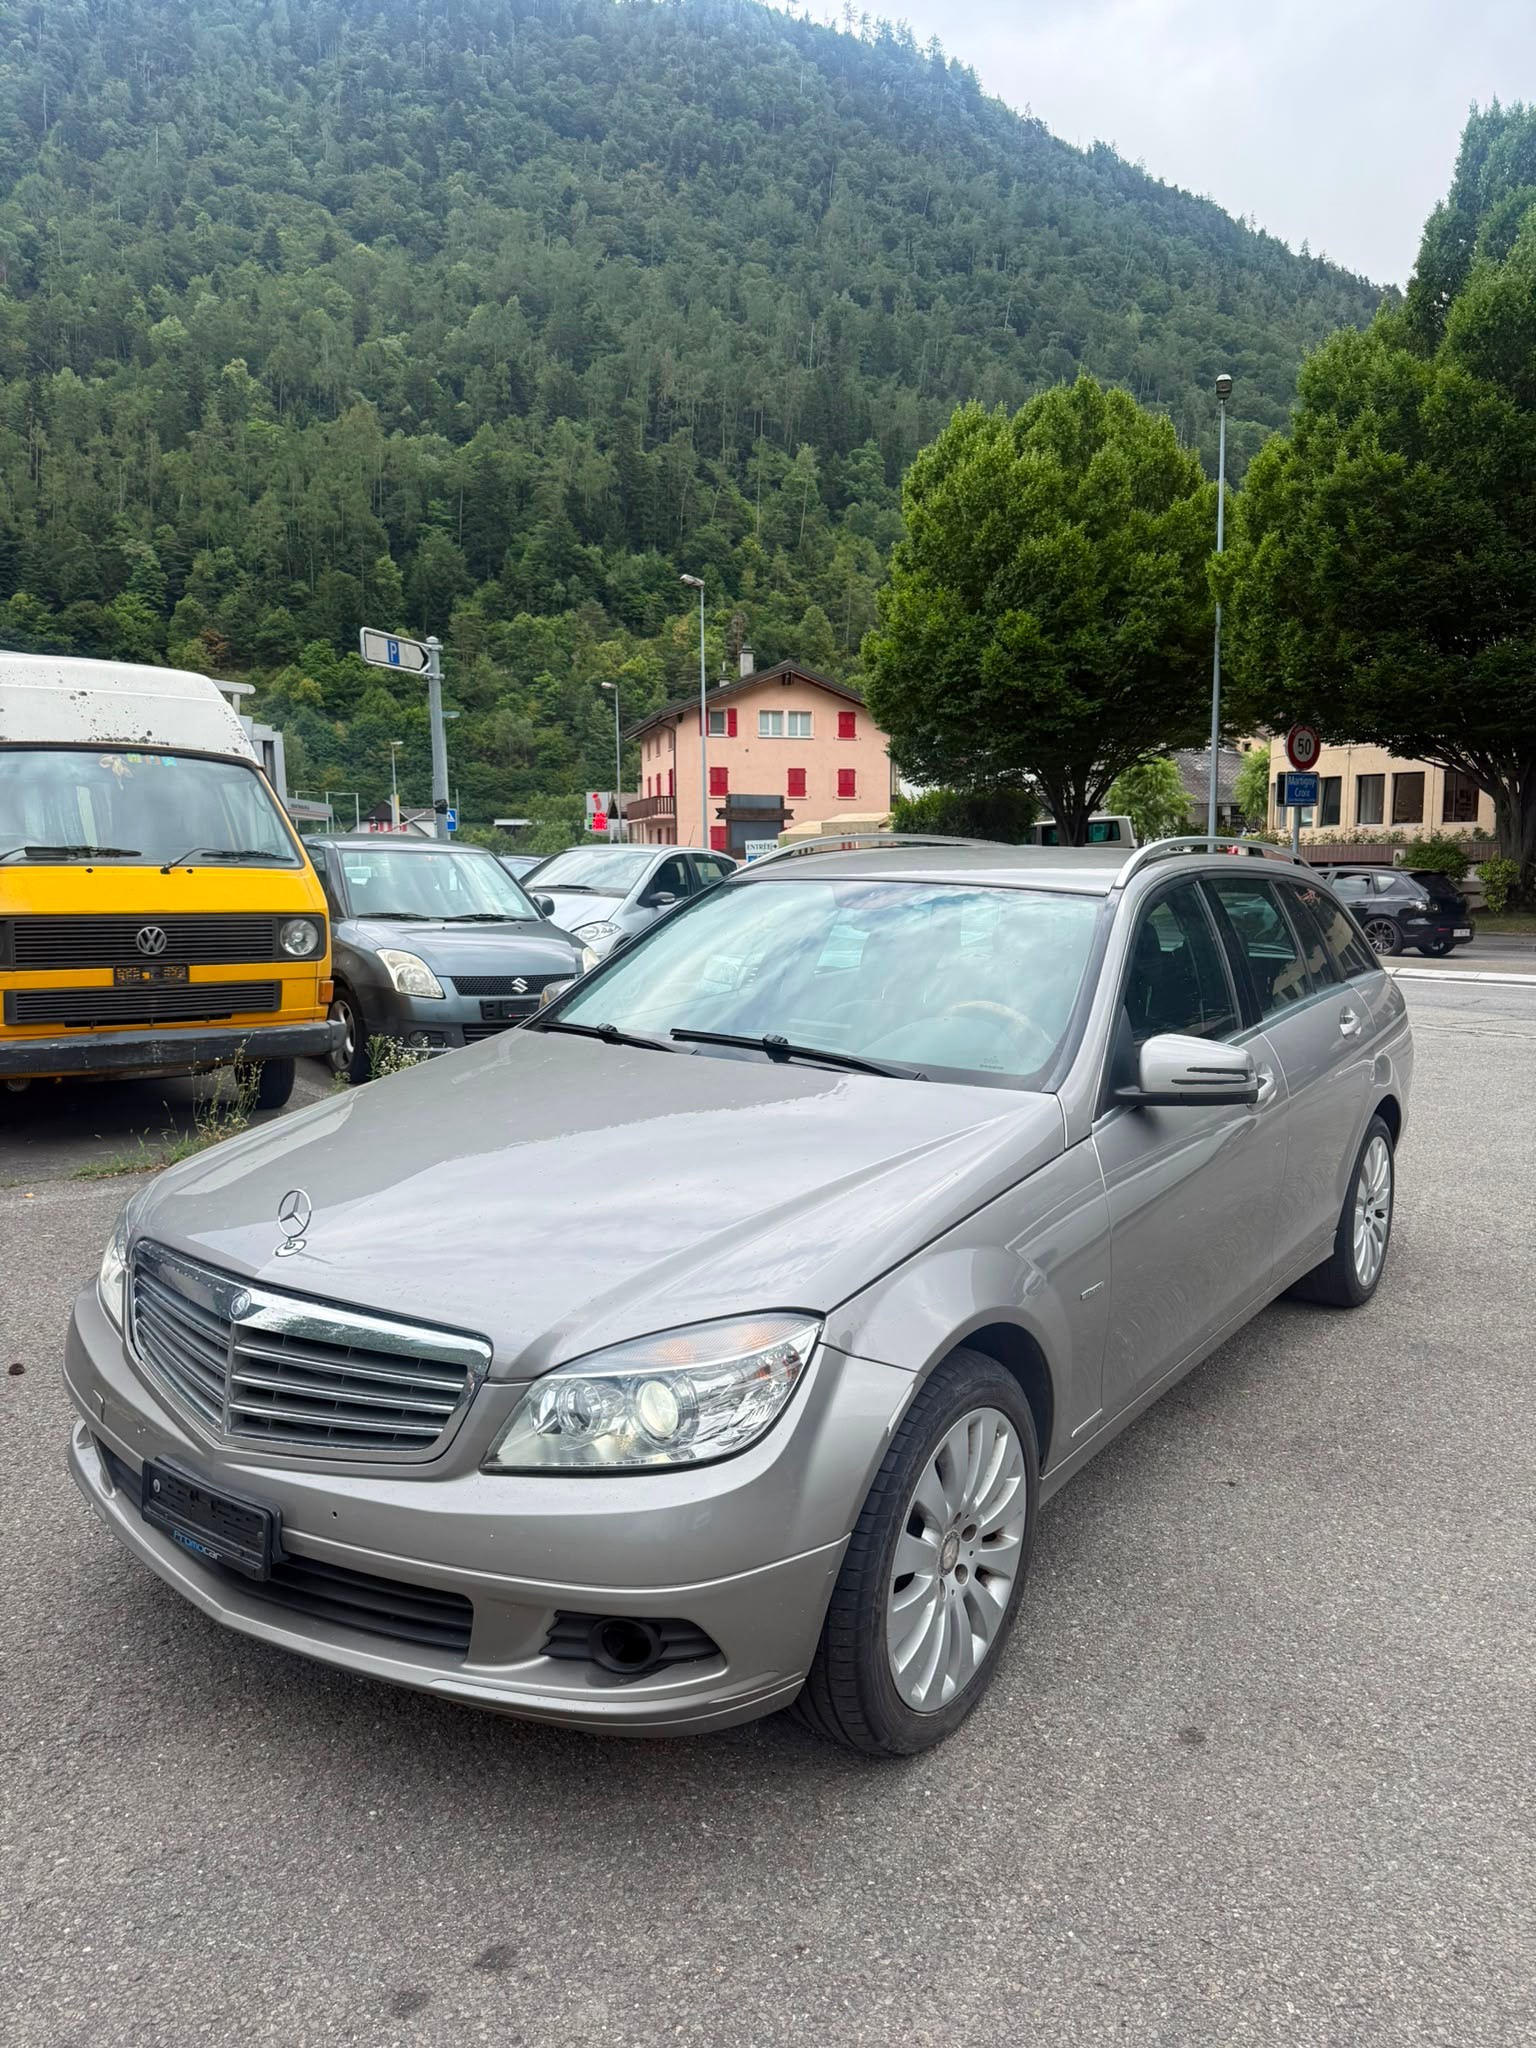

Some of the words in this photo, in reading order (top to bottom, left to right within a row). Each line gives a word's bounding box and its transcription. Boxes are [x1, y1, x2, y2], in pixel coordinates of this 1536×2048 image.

[390, 642, 398, 661] P
[1298, 738, 1312, 755] 50
[1294, 787, 1311, 797] Croix
[173, 1530, 223, 1560] Promocar
